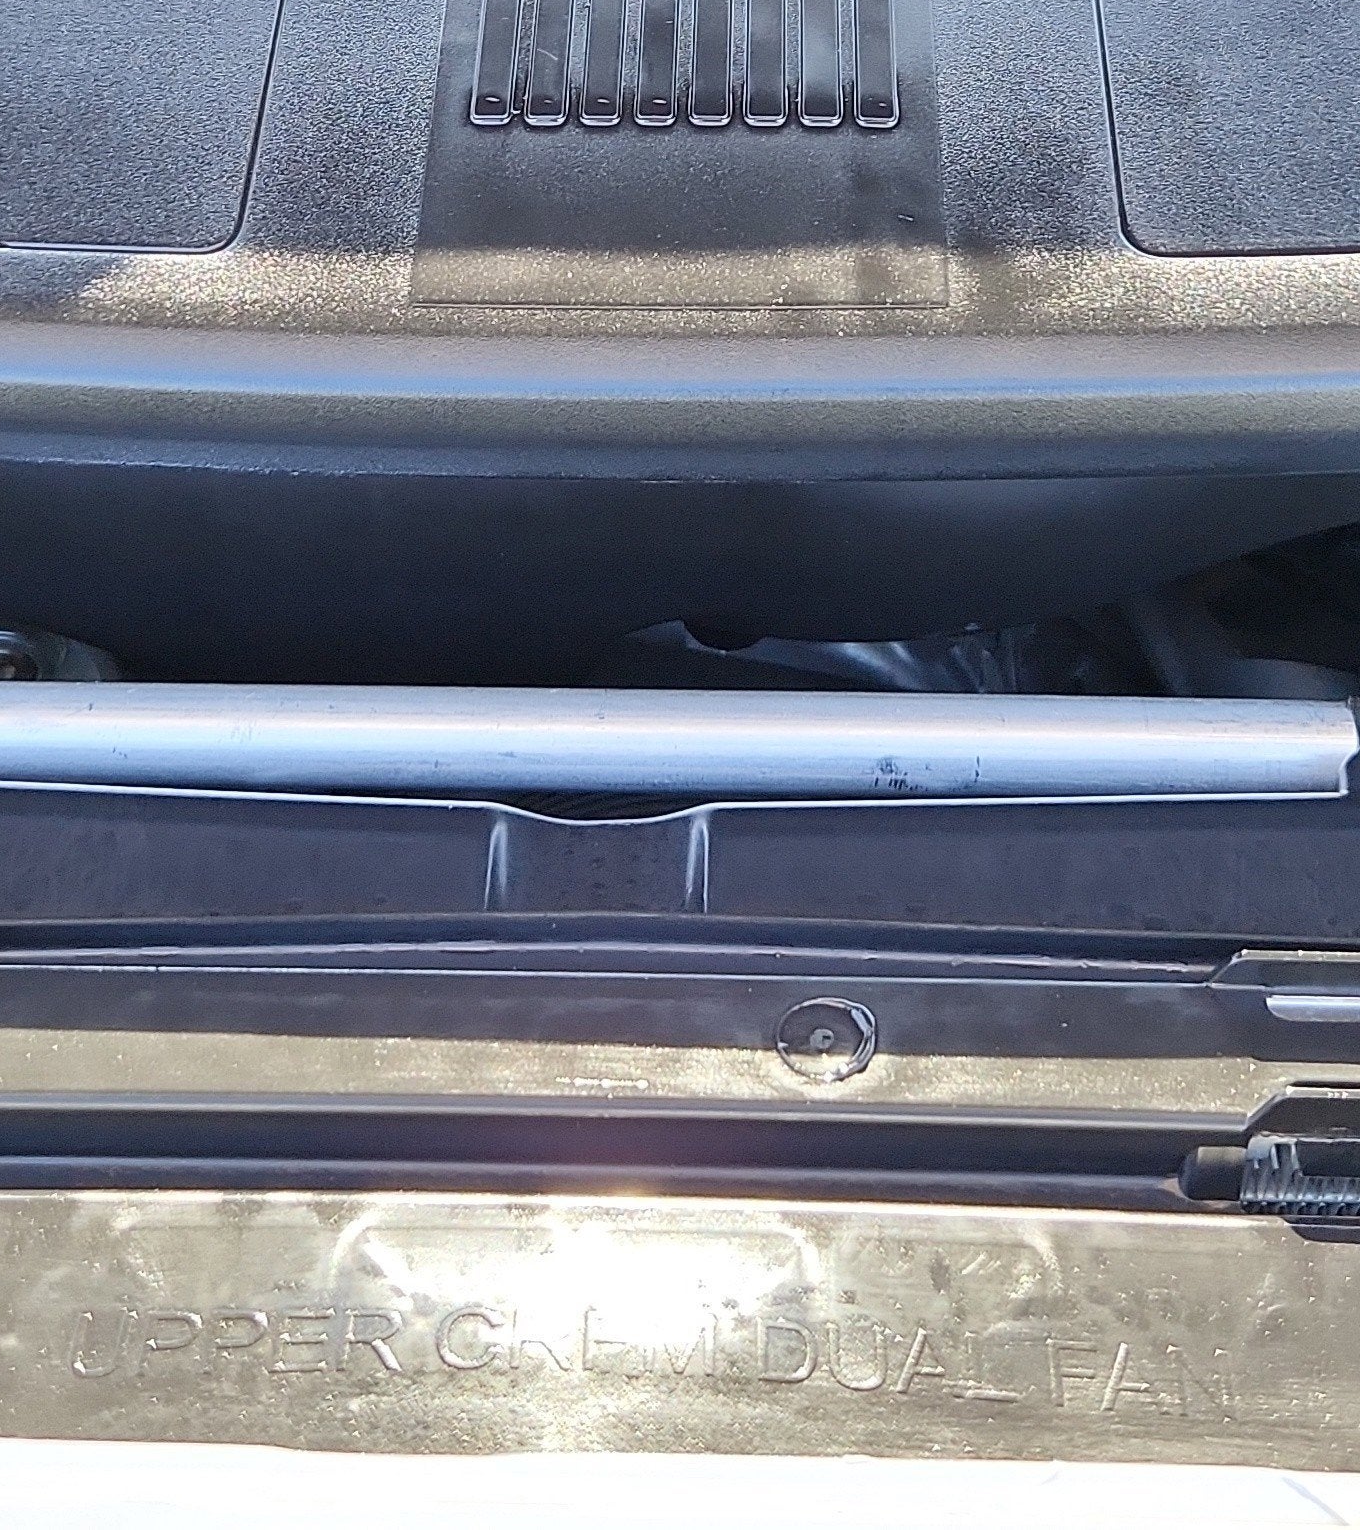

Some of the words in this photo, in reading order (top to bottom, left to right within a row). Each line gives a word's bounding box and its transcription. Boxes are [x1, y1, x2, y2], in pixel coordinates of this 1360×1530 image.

[70, 1307, 404, 1378] UPPER
[755, 1316, 1024, 1404] DUAL
[1044, 1337, 1242, 1421] FAN
